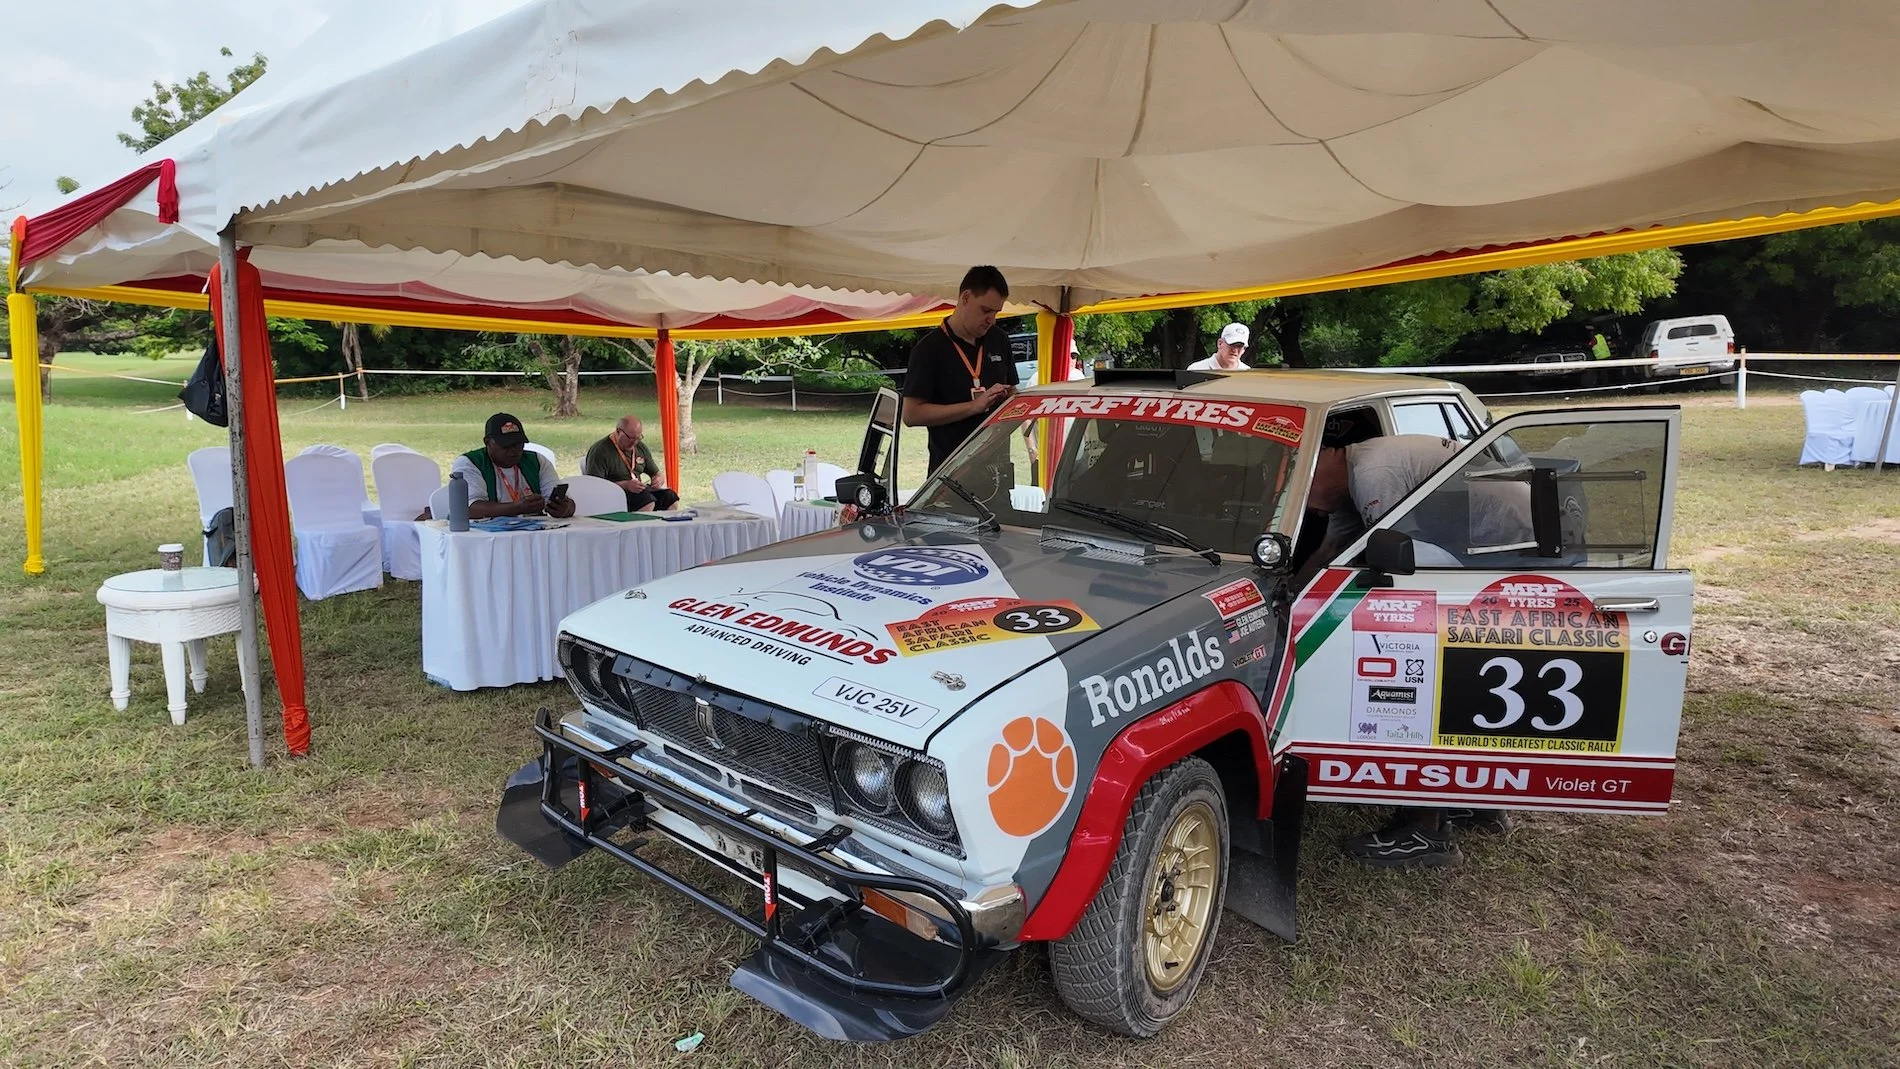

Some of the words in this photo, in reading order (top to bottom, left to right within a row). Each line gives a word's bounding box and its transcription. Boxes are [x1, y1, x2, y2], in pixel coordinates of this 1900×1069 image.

[1029, 397, 1131, 417] MRF
[1133, 398, 1255, 427] TYRES
[867, 555, 962, 577] VDI
[809, 582, 877, 602] Institute
[849, 580, 933, 605] Dynamics
[1500, 583, 1564, 597] MRF
[1366, 599, 1422, 612] MRF
[1508, 597, 1557, 608] TYRES
[1564, 597, 1581, 607] 25
[897, 619, 940, 632] EAST
[1005, 608, 1071, 631] 33
[1235, 614, 1250, 628] GLEN
[1373, 613, 1415, 623] TYRES
[1448, 609, 1502, 626] EAST
[1511, 610, 1620, 629] AFRICAN
[668, 598, 745, 621] GLEN
[734, 611, 898, 665] EDMUNDS
[902, 619, 988, 639] AFRICAN
[904, 628, 973, 646] SAFARI
[1240, 625, 1250, 637] JOE
[1448, 627, 1523, 645] SAFARI
[1529, 629, 1621, 648] CLASSIC
[683, 623, 752, 646] ADVANCED
[750, 641, 812, 666] DRIVING
[909, 633, 991, 652] CLASSIC
[1380, 642, 1420, 651] VICTORIA
[1661, 632, 1691, 656] G
[1078, 630, 1225, 728] Ronalds
[835, 684, 876, 705] VJC
[873, 698, 919, 718] 25V
[1371, 689, 1414, 700] Aquamist
[1473, 656, 1585, 732] 33
[1366, 706, 1417, 716] DIAMONDS
[1406, 730, 1424, 740] Hills
[1438, 735, 1454, 746] THE
[1457, 736, 1497, 747] WORLD'S
[1499, 737, 1544, 750] GREATEST
[1547, 739, 1586, 751] CLASSIC
[1587, 740, 1617, 753] RALLY
[1319, 760, 1530, 790] DATSUN
[1545, 776, 1596, 792] Violet
[1602, 779, 1632, 794] GT
[763, 877, 772, 905] TOW
